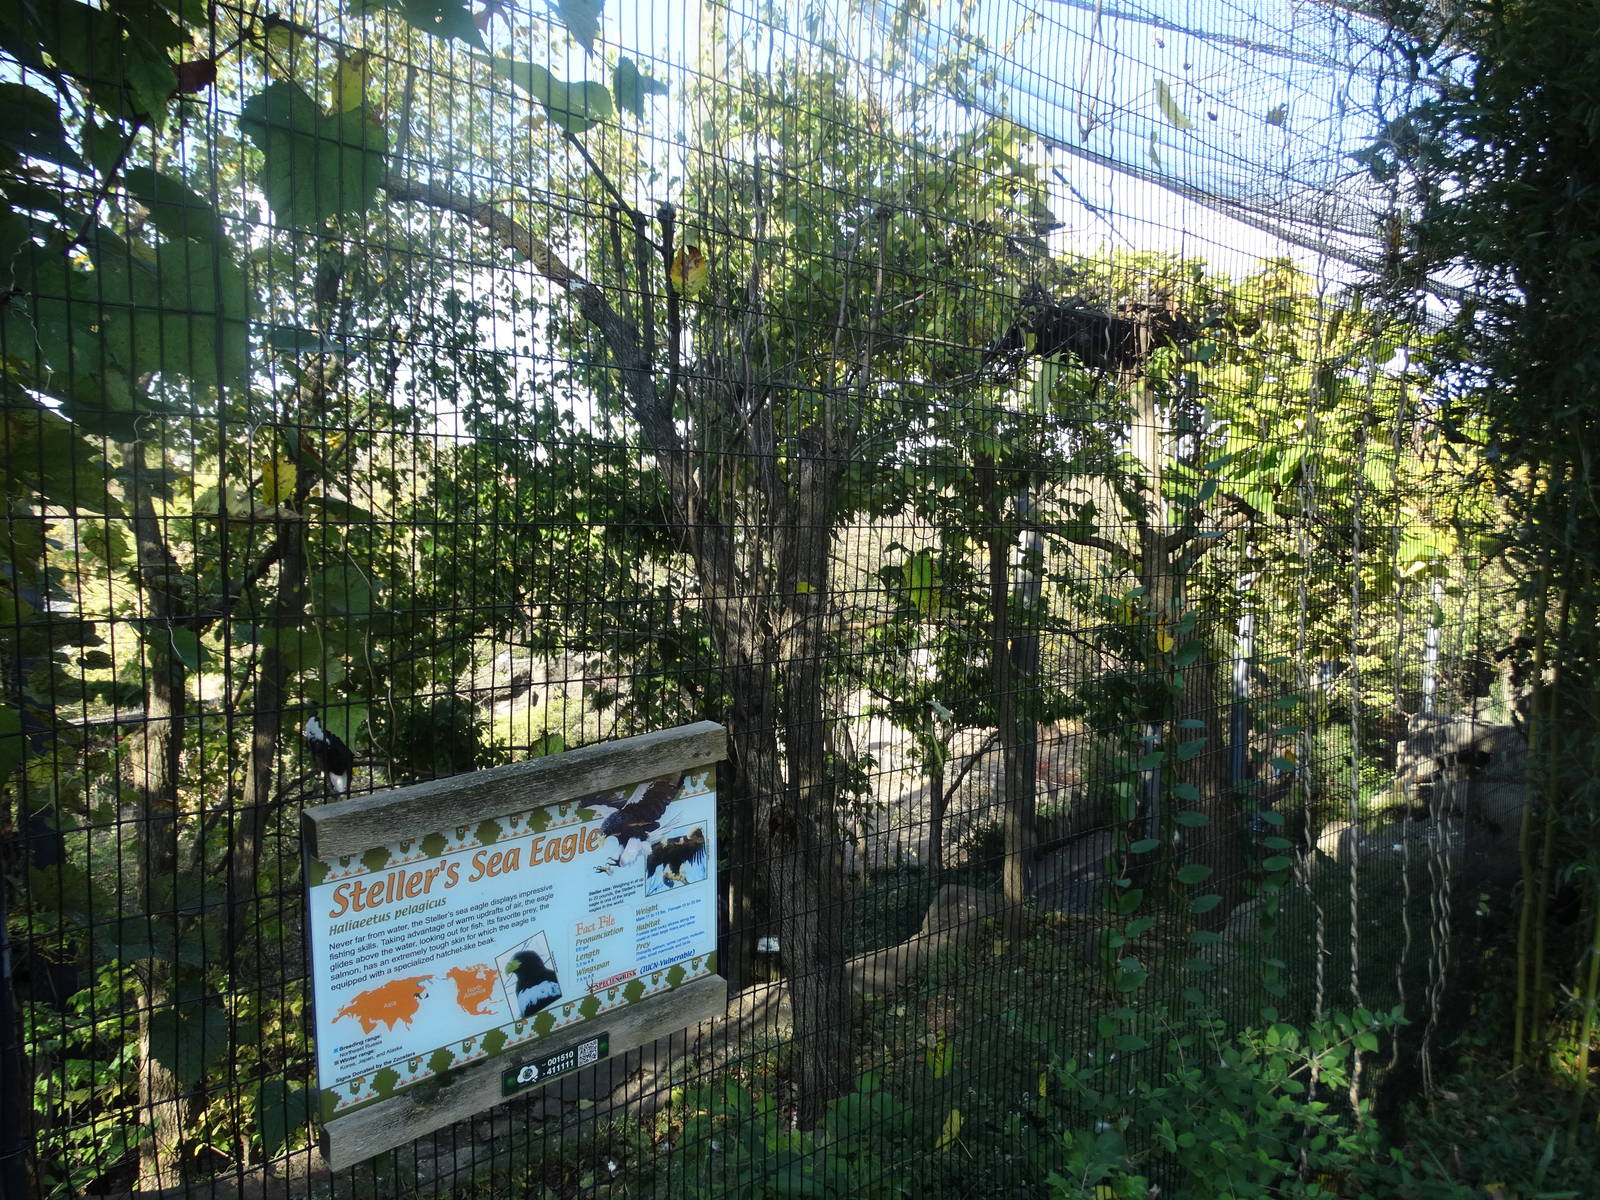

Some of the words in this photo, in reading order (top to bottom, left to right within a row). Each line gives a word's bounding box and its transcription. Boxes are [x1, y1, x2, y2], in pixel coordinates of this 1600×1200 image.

[329, 860, 460, 918] Steller's
[468, 847, 521, 882] Sea
[529, 826, 600, 867] Eagle
[329, 912, 391, 936] Haliaeetus
[395, 897, 447, 920] pelagicus
[329, 939, 353, 951] Never
[355, 936, 366, 944] far
[368, 931, 385, 941] from
[387, 924, 410, 935] water,
[426, 912, 454, 924] Steller's
[456, 907, 469, 915] sea
[470, 902, 489, 912] eagle
[490, 896, 518, 906] displays
[519, 884, 553, 898] impressive
[636, 904, 658, 916] Weight
[330, 948, 355, 961] fishing
[358, 943, 379, 953] skills.
[382, 934, 405, 947] Taking
[408, 924, 445, 938] advantage
[447, 920, 454, 928] of
[456, 915, 475, 925] warm
[477, 907, 504, 920] updrafts
[505, 903, 513, 911] of
[537, 893, 554, 902] eagle
[576, 922, 595, 936] Fact
[598, 914, 615, 930] File
[636, 919, 661, 932] Habitat
[330, 960, 354, 972] glides
[356, 952, 379, 963] above
[382, 948, 394, 956] the
[396, 942, 418, 951] water,
[420, 932, 445, 945] looking
[446, 929, 458, 937] out
[460, 926, 469, 934] for
[496, 911, 521, 923] favorite
[540, 903, 550, 911] the
[576, 926, 624, 946] Pronunciation
[330, 967, 361, 981] salmon,
[364, 962, 378, 971] has
[380, 959, 390, 967] an
[392, 946, 428, 963] extremely
[430, 940, 449, 952] tough
[451, 936, 465, 945] skin
[467, 932, 476, 940] for
[478, 926, 498, 938] which
[499, 923, 510, 931] the
[511, 918, 529, 928] eagle
[576, 947, 600, 962] Length
[636, 940, 651, 951] Prey
[330, 974, 367, 991] equipped
[370, 969, 385, 979] with
[394, 955, 435, 972] specialized
[436, 942, 476, 959] hatchet-like
[478, 937, 496, 947] beak.
[576, 960, 610, 977] Wingspan
[640, 949, 696, 975] (IUCN-Vulnerable)
[339, 1040, 364, 1052] Breeding
[340, 1054, 357, 1064] Winter
[547, 1060, 574, 1075] 411111
[548, 1051, 574, 1066] 001510
[352, 1065, 375, 1077] Donated
